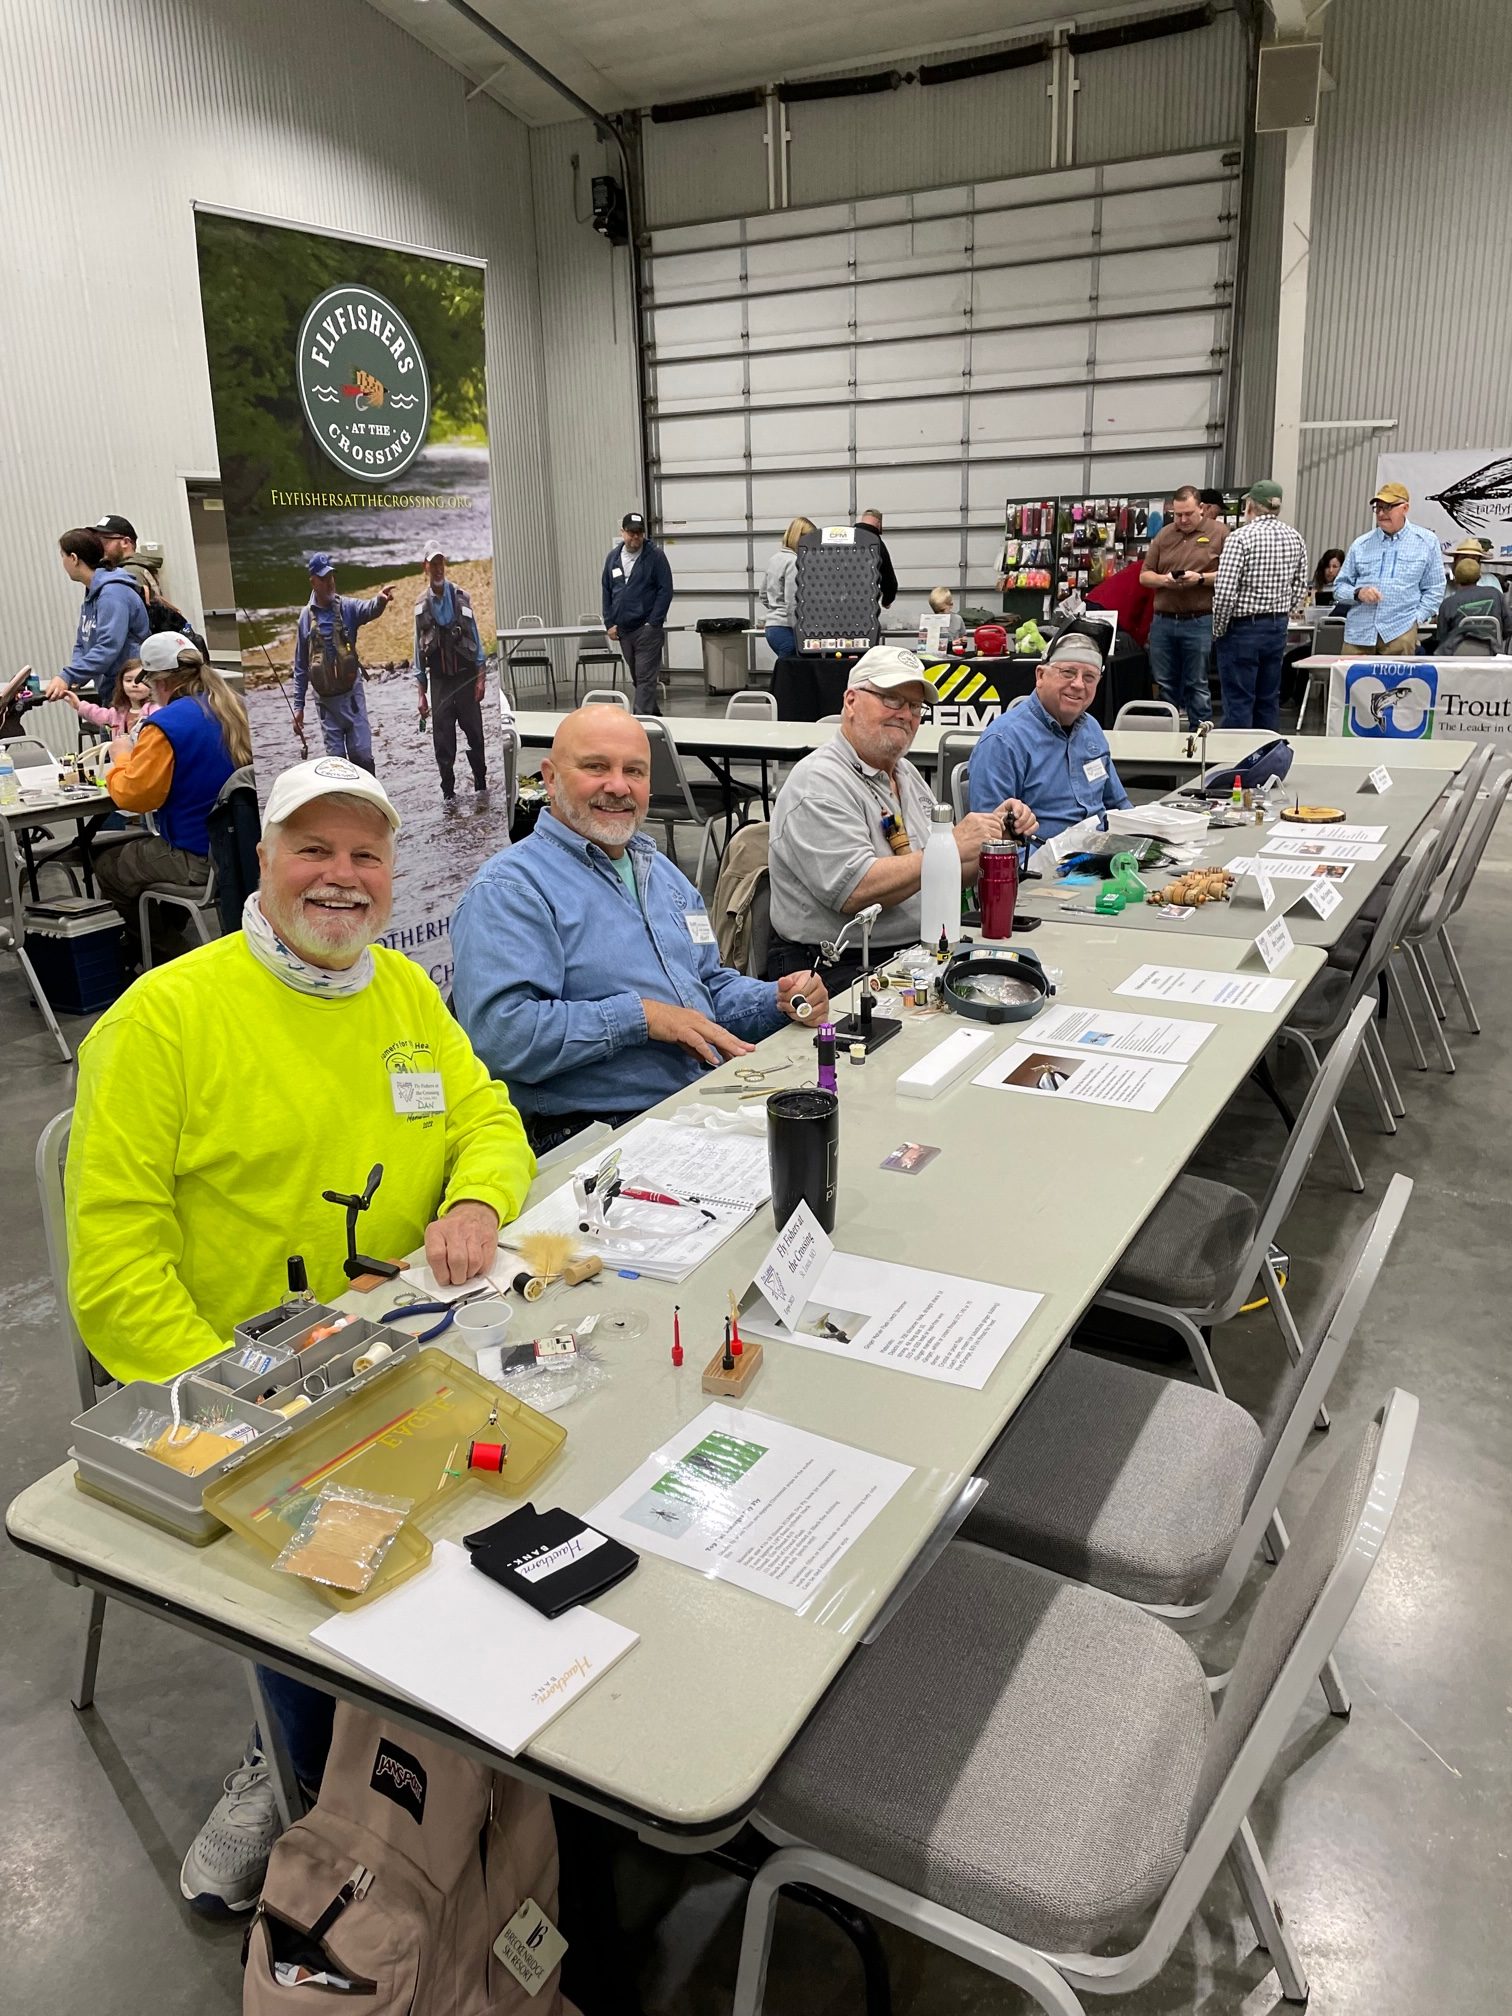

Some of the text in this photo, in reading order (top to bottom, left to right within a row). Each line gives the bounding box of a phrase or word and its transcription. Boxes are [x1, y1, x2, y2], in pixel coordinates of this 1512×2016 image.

[312, 305, 414, 374] FLYFISHERS
[329, 423, 412, 464] CROSSING
[351, 423, 390, 436] AT THE
[1371, 663, 1415, 676] TROUT
[1440, 694, 1512, 717] Trout
[1439, 722, 1458, 732] The
[1459, 722, 1491, 733] Leader
[1494, 723, 1504, 732] in
[777, 1243, 789, 1258] Fly
[783, 1222, 801, 1248] Fishers
[794, 1231, 815, 1262] Crossing
[513, 1544, 549, 1566] BANK
[521, 1539, 584, 1575] Hawthorn
[537, 1656, 593, 1705] Hawthorn
[376, 1754, 423, 1800] JANSPORT
[503, 1944, 533, 1982] SKI RESORT
[504, 1928, 545, 1979] BRECKENRIDGE
